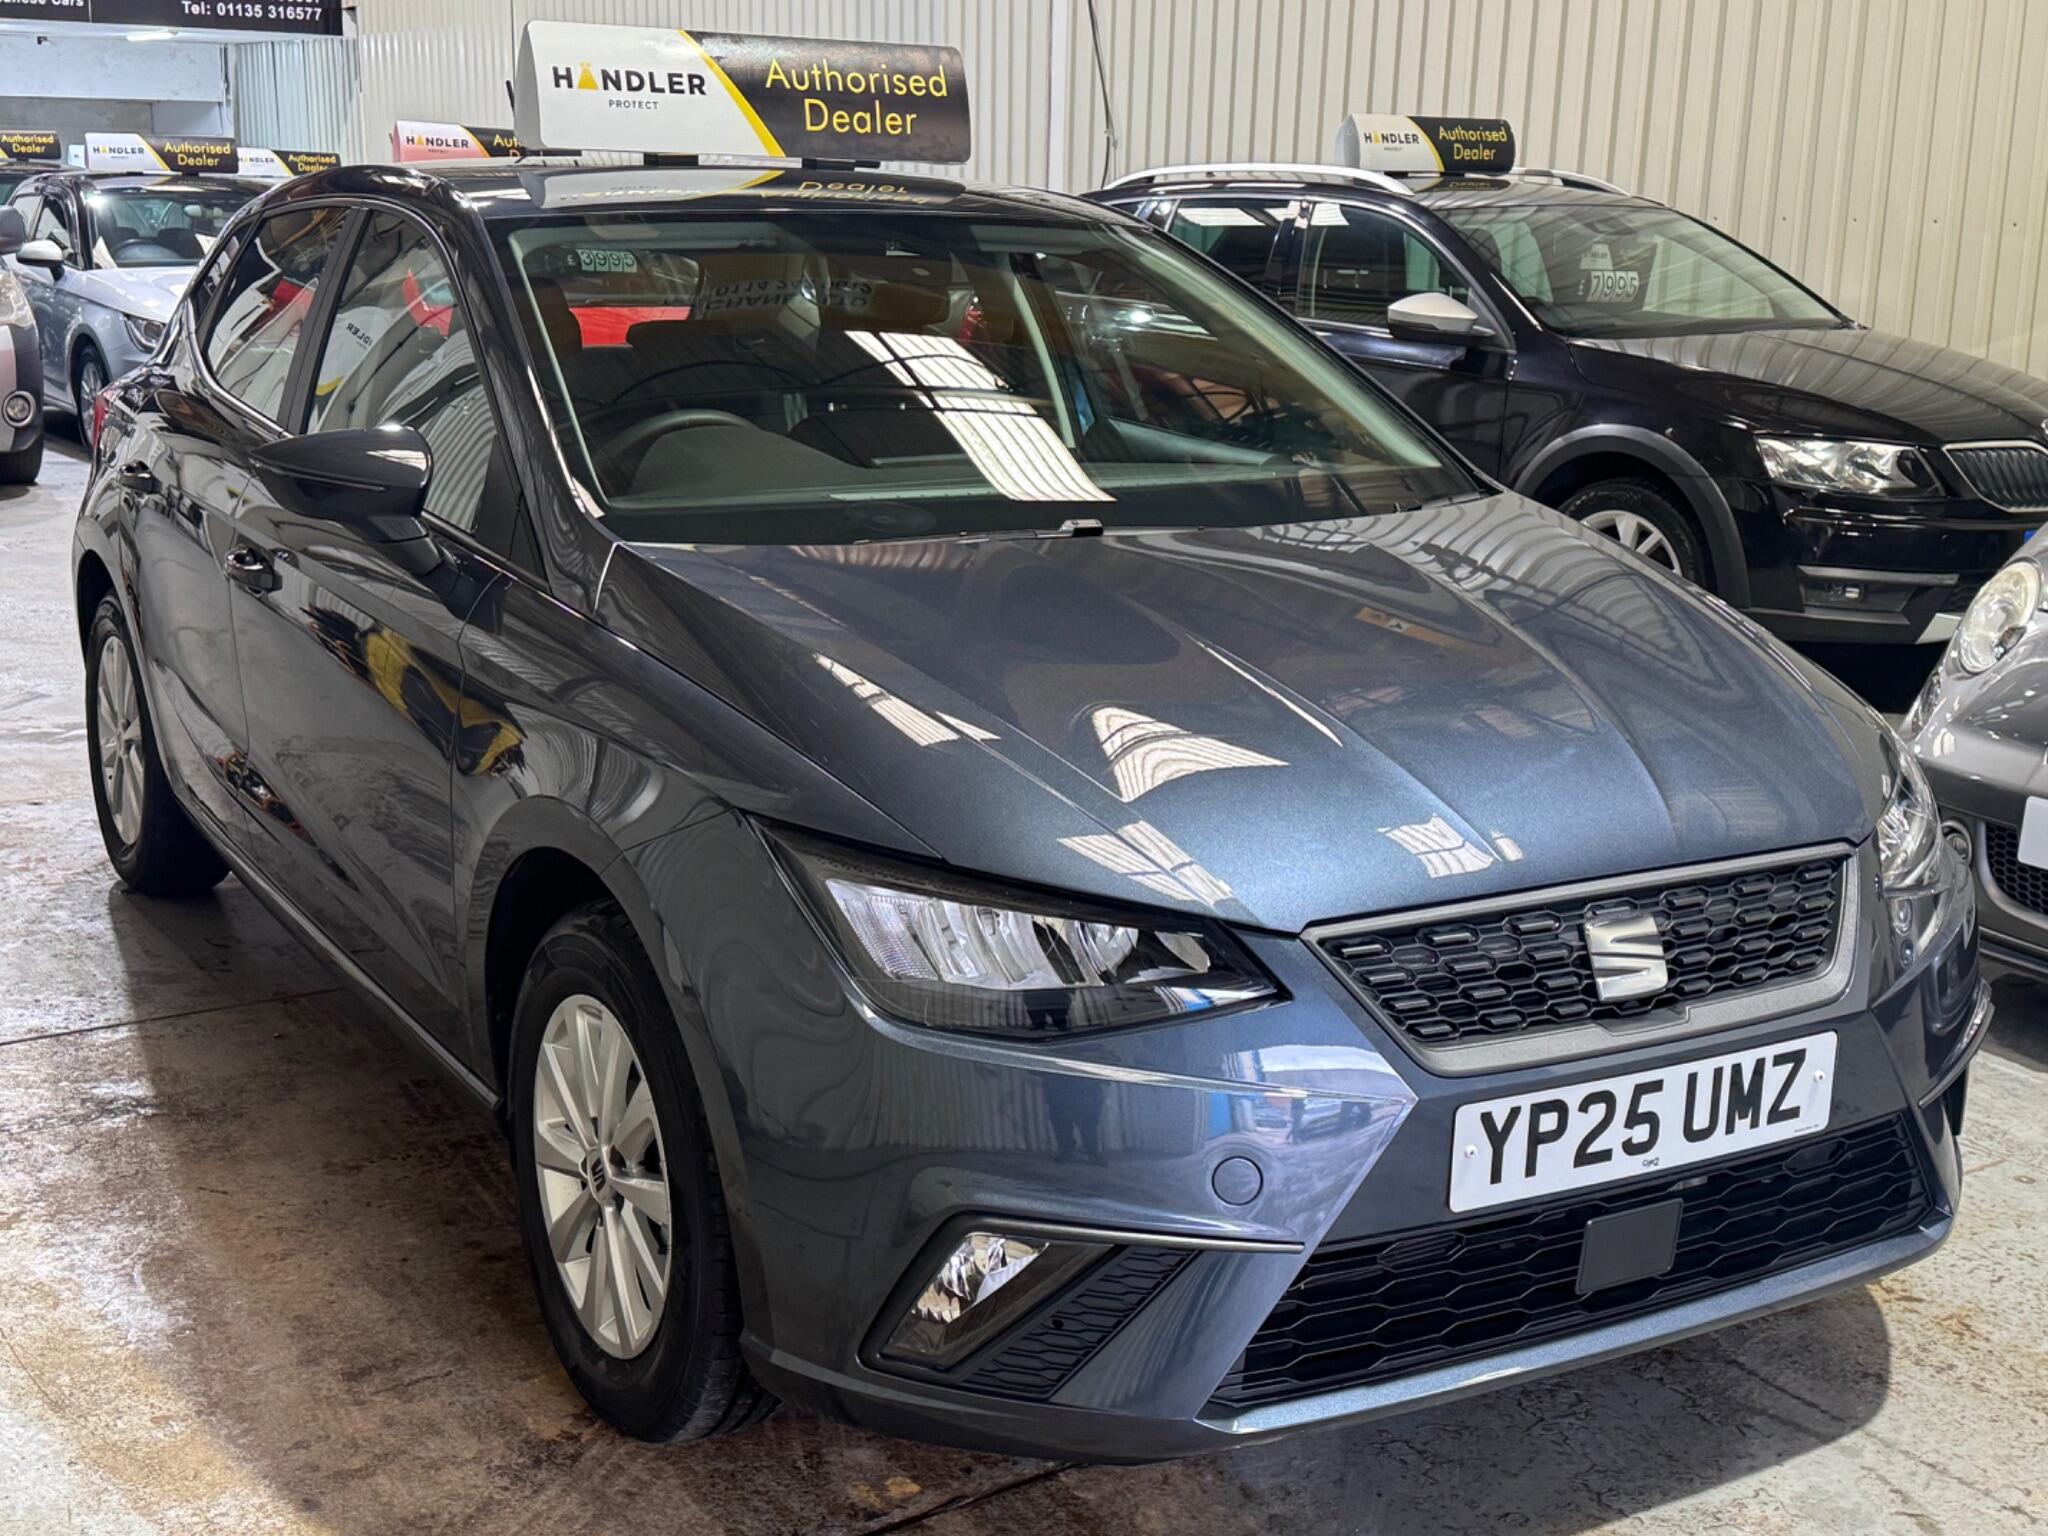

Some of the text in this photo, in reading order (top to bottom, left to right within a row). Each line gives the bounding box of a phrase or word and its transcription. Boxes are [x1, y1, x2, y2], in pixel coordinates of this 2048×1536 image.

[181, 1, 322, 21] Tel: 01135 316577
[765, 58, 948, 98] Authorised
[608, 99, 659, 110] PROTECT
[803, 98, 917, 136] Dealer
[1438, 126, 1508, 142] Authorised
[12, 143, 46, 153] Dealer
[164, 141, 231, 155] Authorised
[1453, 143, 1497, 161] Dealer
[177, 154, 219, 167] Dealer
[288, 154, 336, 164] Authorised
[1480, 1048, 1808, 1185] YP25 UMZ
